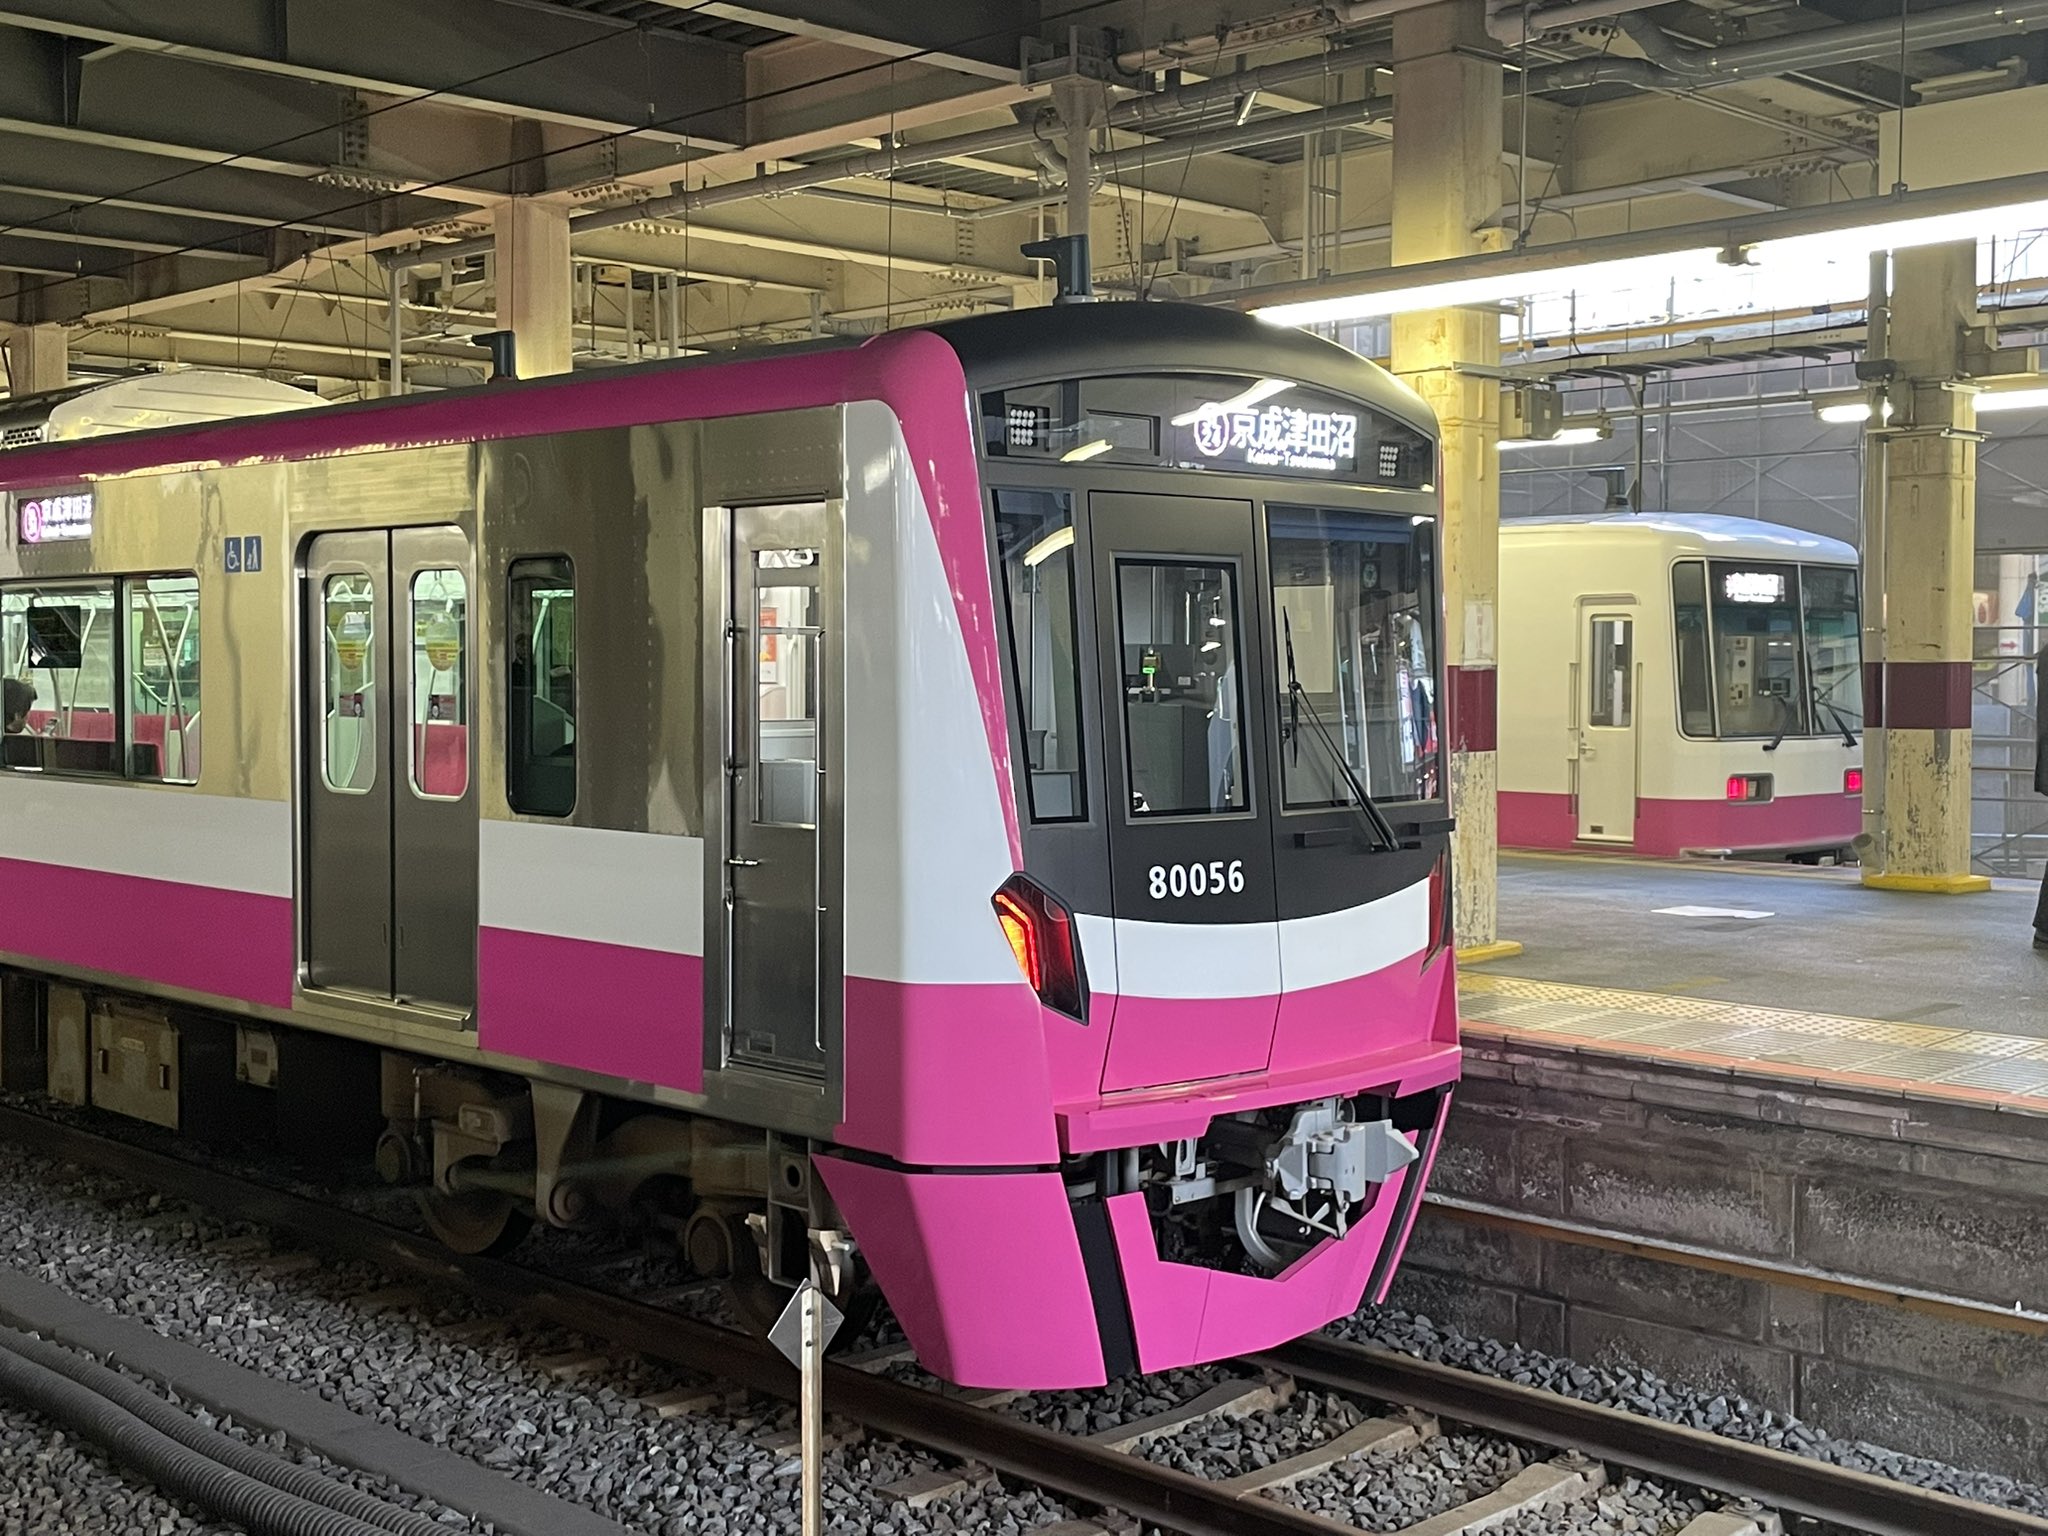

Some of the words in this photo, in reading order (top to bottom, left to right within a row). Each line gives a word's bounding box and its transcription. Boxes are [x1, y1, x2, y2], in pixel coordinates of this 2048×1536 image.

[1230, 405, 1357, 459] 京成津田沼
[1148, 859, 1245, 900] 80056
